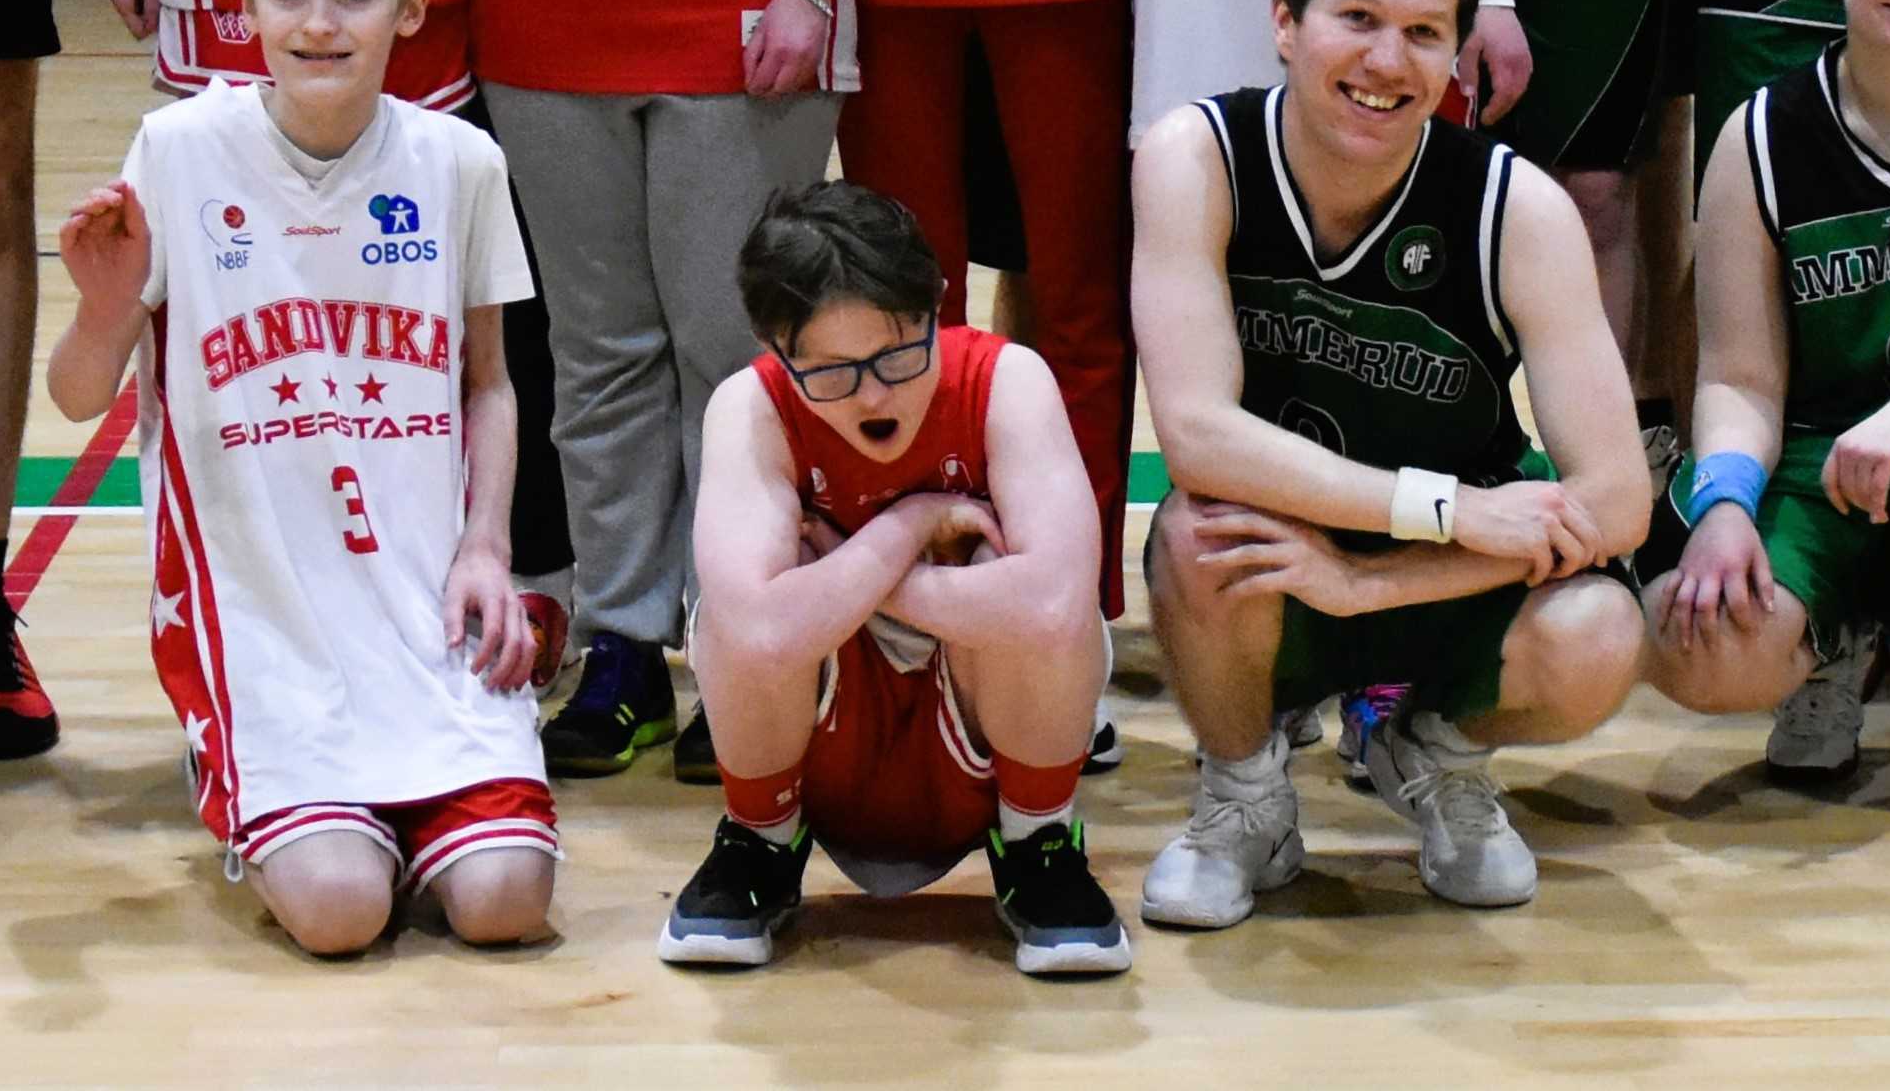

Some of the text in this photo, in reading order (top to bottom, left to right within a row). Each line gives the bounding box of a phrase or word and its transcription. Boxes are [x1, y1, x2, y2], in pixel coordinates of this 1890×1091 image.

[282, 224, 342, 237] SoulSport
[216, 250, 250, 271] NBBF
[361, 239, 438, 266] OBOS
[1403, 242, 1432, 274] AIF
[200, 296, 450, 392] SANDVIKA
[1234, 306, 1472, 404] MMERUD
[219, 411, 451, 450] SUPERSTARS
[331, 465, 380, 555] 3
